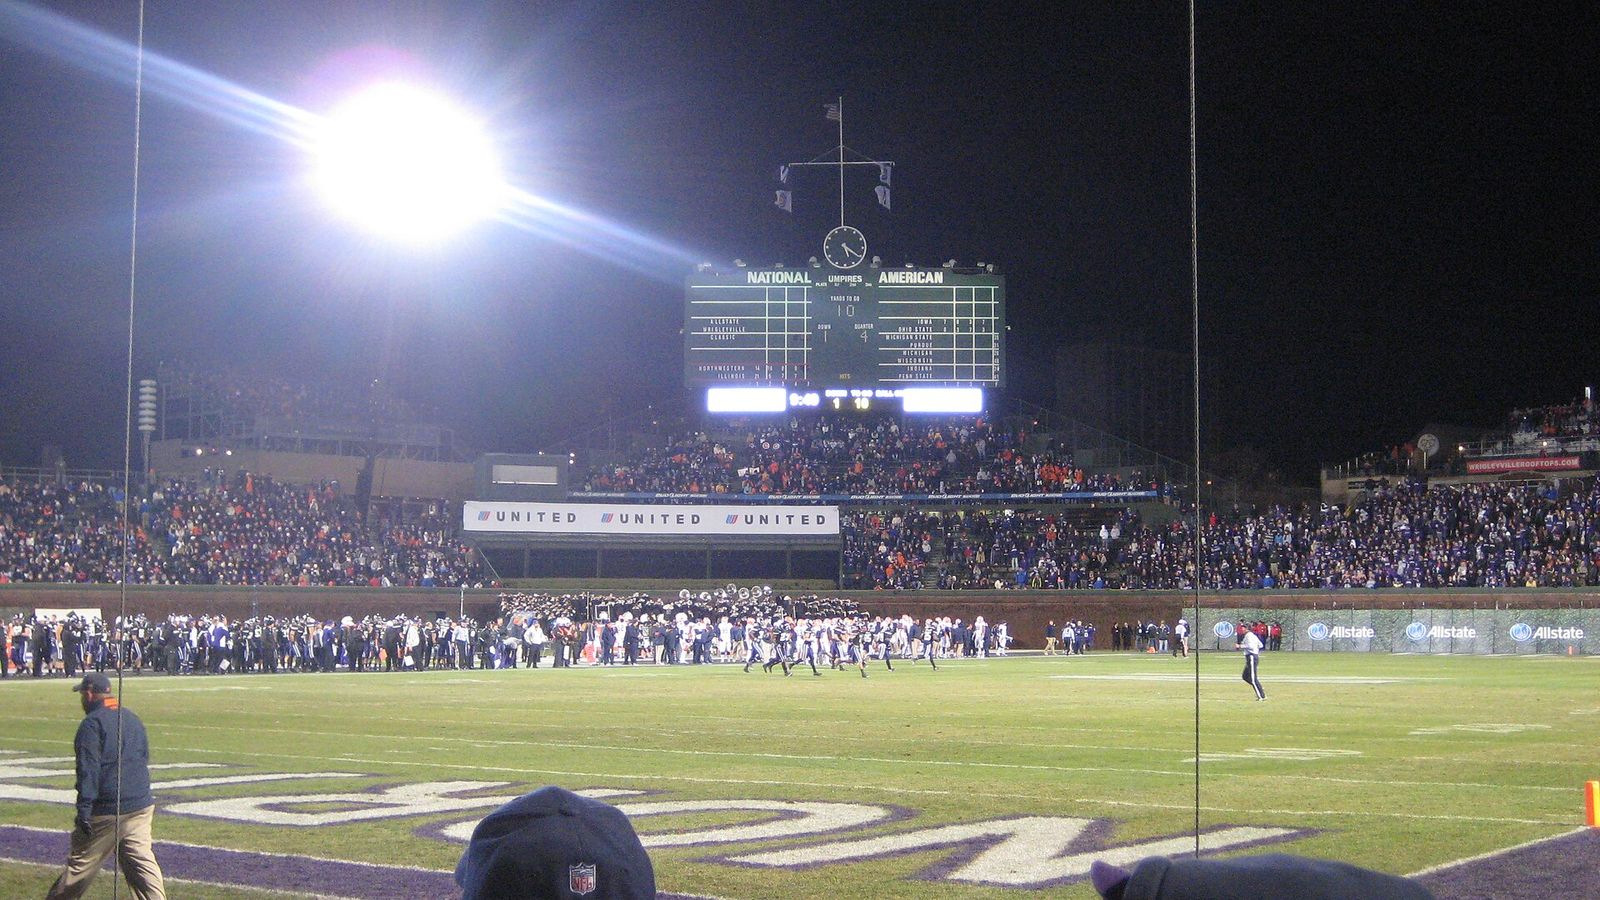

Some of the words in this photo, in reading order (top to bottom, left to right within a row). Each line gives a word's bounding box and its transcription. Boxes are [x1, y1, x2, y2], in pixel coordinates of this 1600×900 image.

[747, 271, 812, 284] NATIONAL
[828, 275, 863, 283] UMPIRES
[878, 271, 944, 284] AMERICAN
[859, 330, 868, 343] 4
[832, 397, 840, 409] 1
[854, 397, 869, 409] 10
[496, 511, 577, 523] UNITED
[619, 513, 700, 525] UNITED
[744, 514, 826, 525] UNITED
[1328, 626, 1374, 638] Allstate
[1427, 625, 1476, 638] Allstate
[1532, 626, 1584, 639] Allstate
[574, 877, 594, 892] NFL
